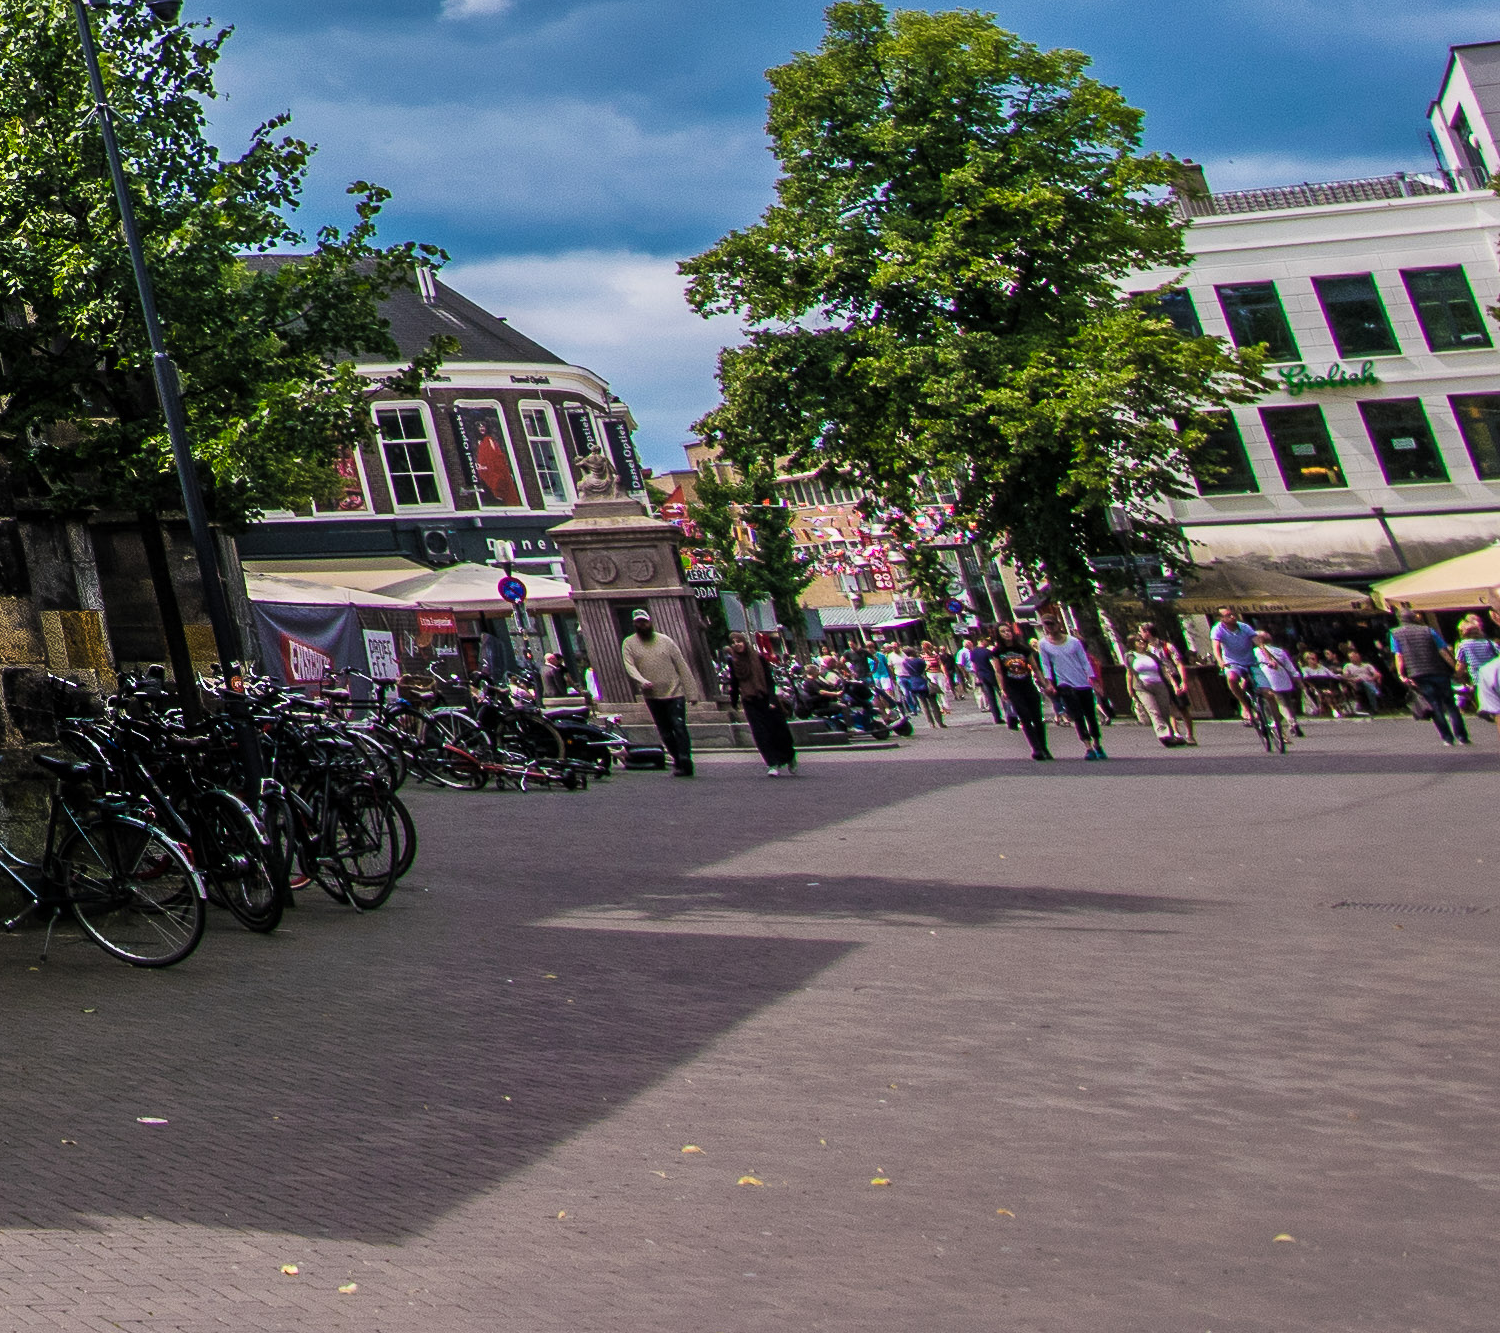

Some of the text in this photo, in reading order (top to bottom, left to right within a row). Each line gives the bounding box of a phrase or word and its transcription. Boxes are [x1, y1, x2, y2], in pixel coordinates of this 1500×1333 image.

[1277, 360, 1379, 396] Grolsch
[616, 424, 640, 488] Danel Optiek
